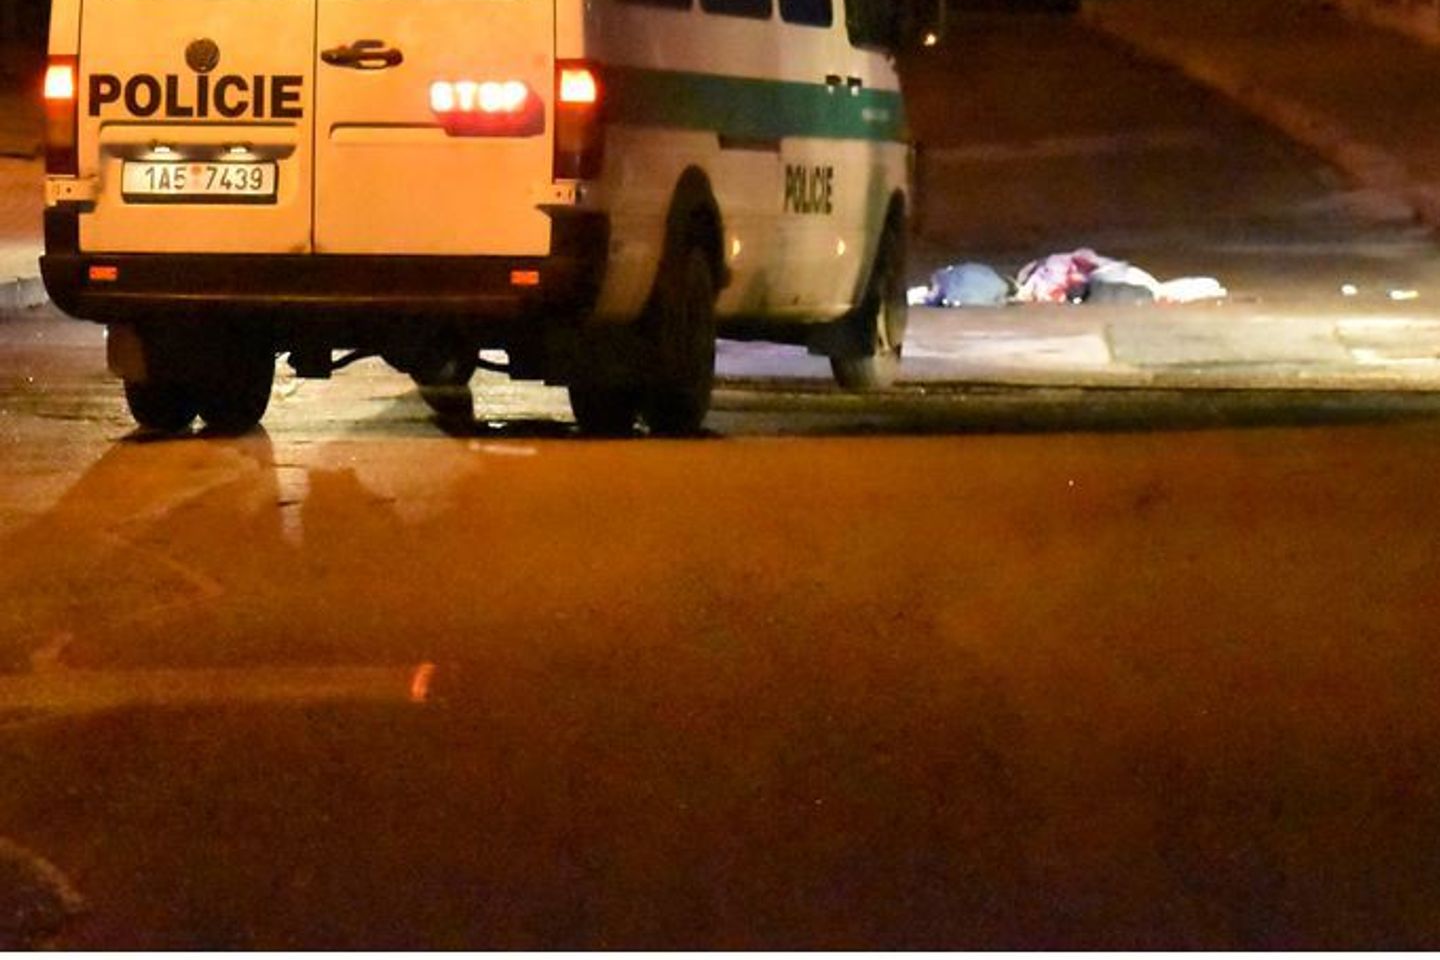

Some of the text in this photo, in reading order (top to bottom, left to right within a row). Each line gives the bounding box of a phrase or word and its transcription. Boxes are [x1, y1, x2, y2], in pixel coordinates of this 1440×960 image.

[88, 74, 304, 119] POLICIE
[145, 167, 264, 191] 1A5 7439
[783, 163, 834, 216] POLICIE
